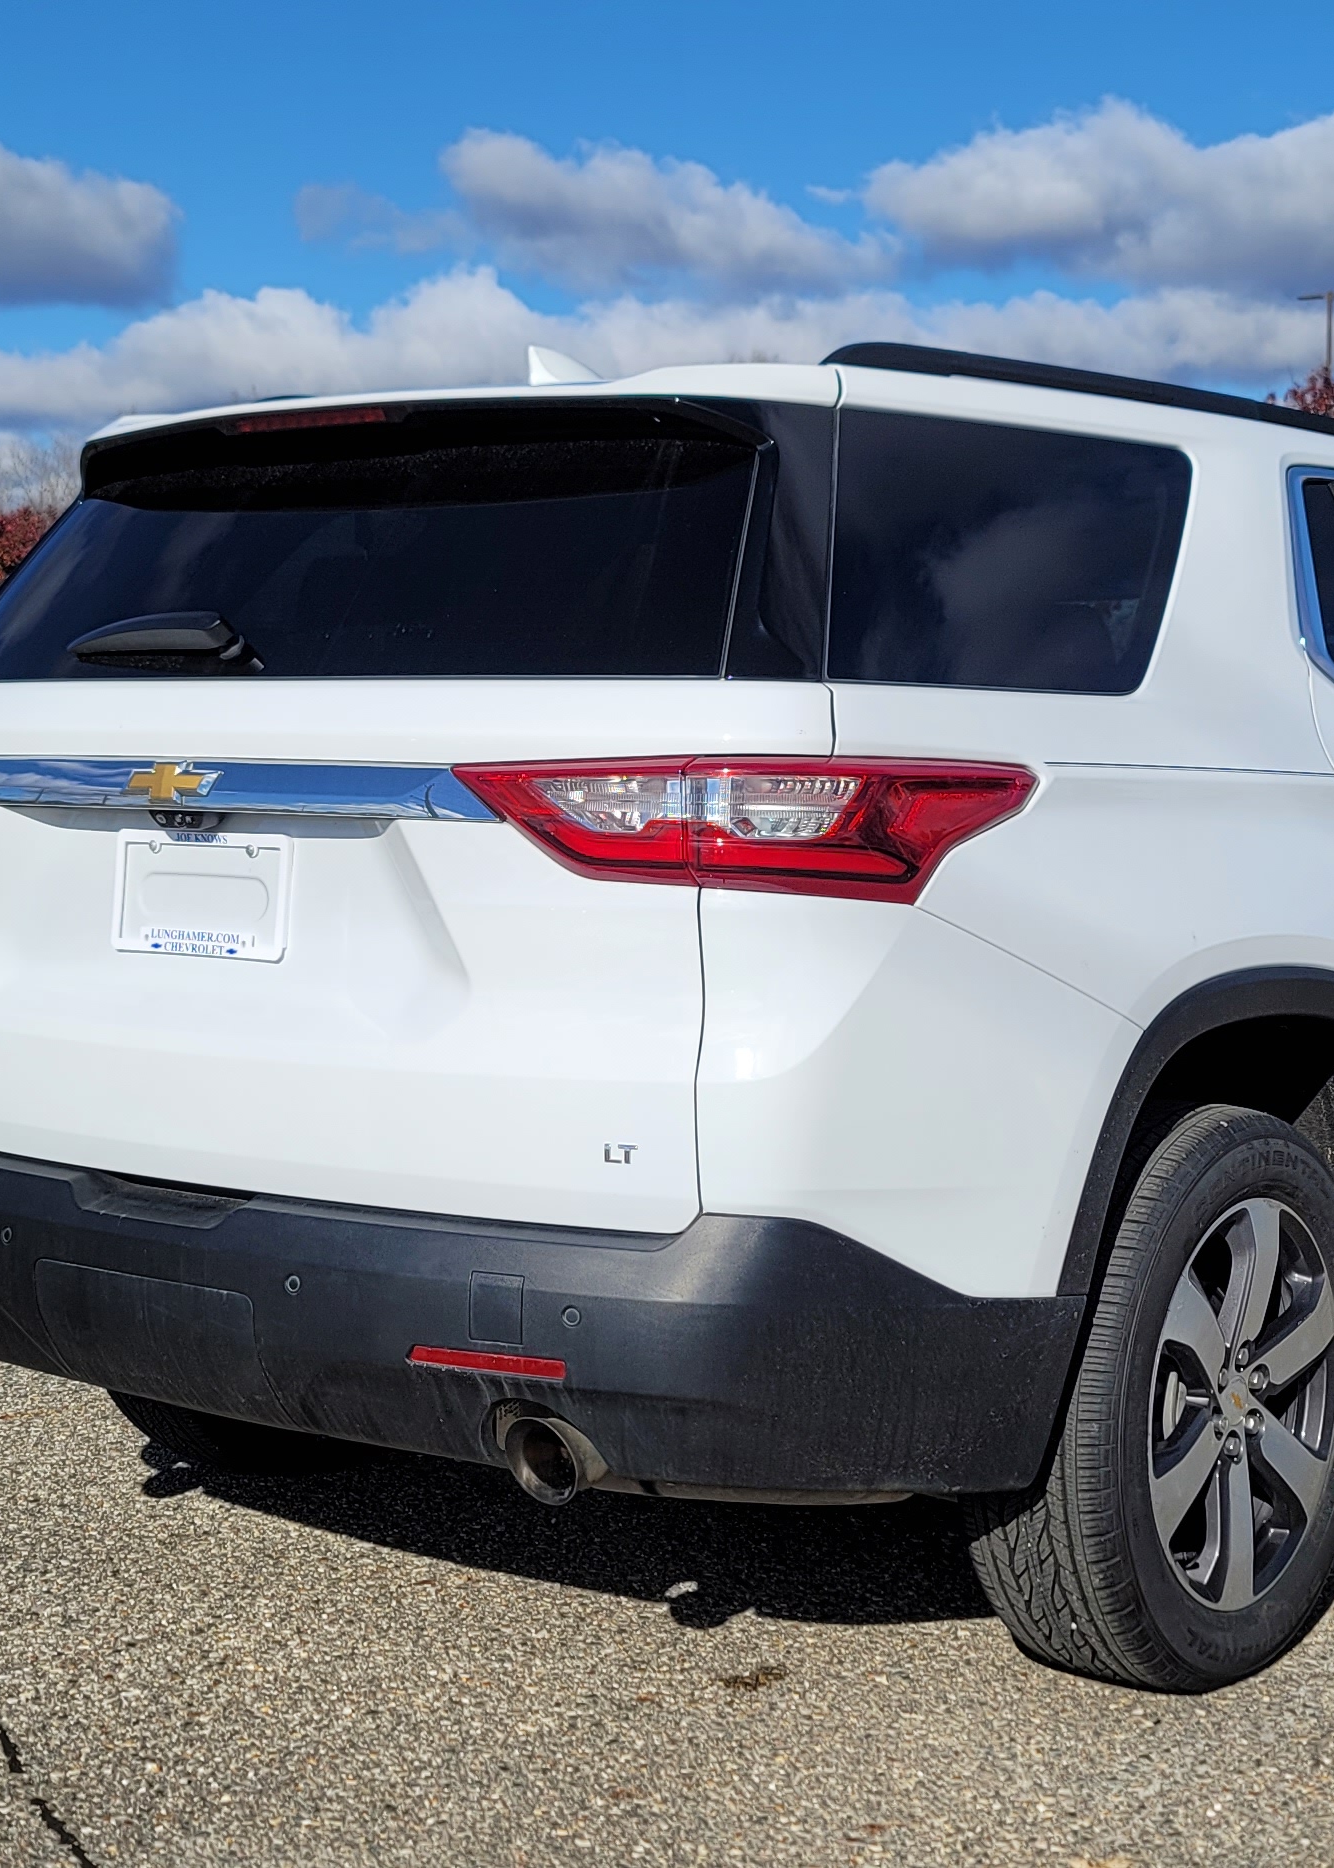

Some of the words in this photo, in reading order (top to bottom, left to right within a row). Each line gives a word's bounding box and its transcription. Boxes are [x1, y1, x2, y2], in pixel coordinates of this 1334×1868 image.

[175, 832, 192, 842] JOE
[194, 833, 228, 845] KNOWS
[150, 928, 240, 945] LUNGHAMER.COM
[164, 941, 225, 956] CHEVROLET
[604, 1143, 639, 1164] LT
